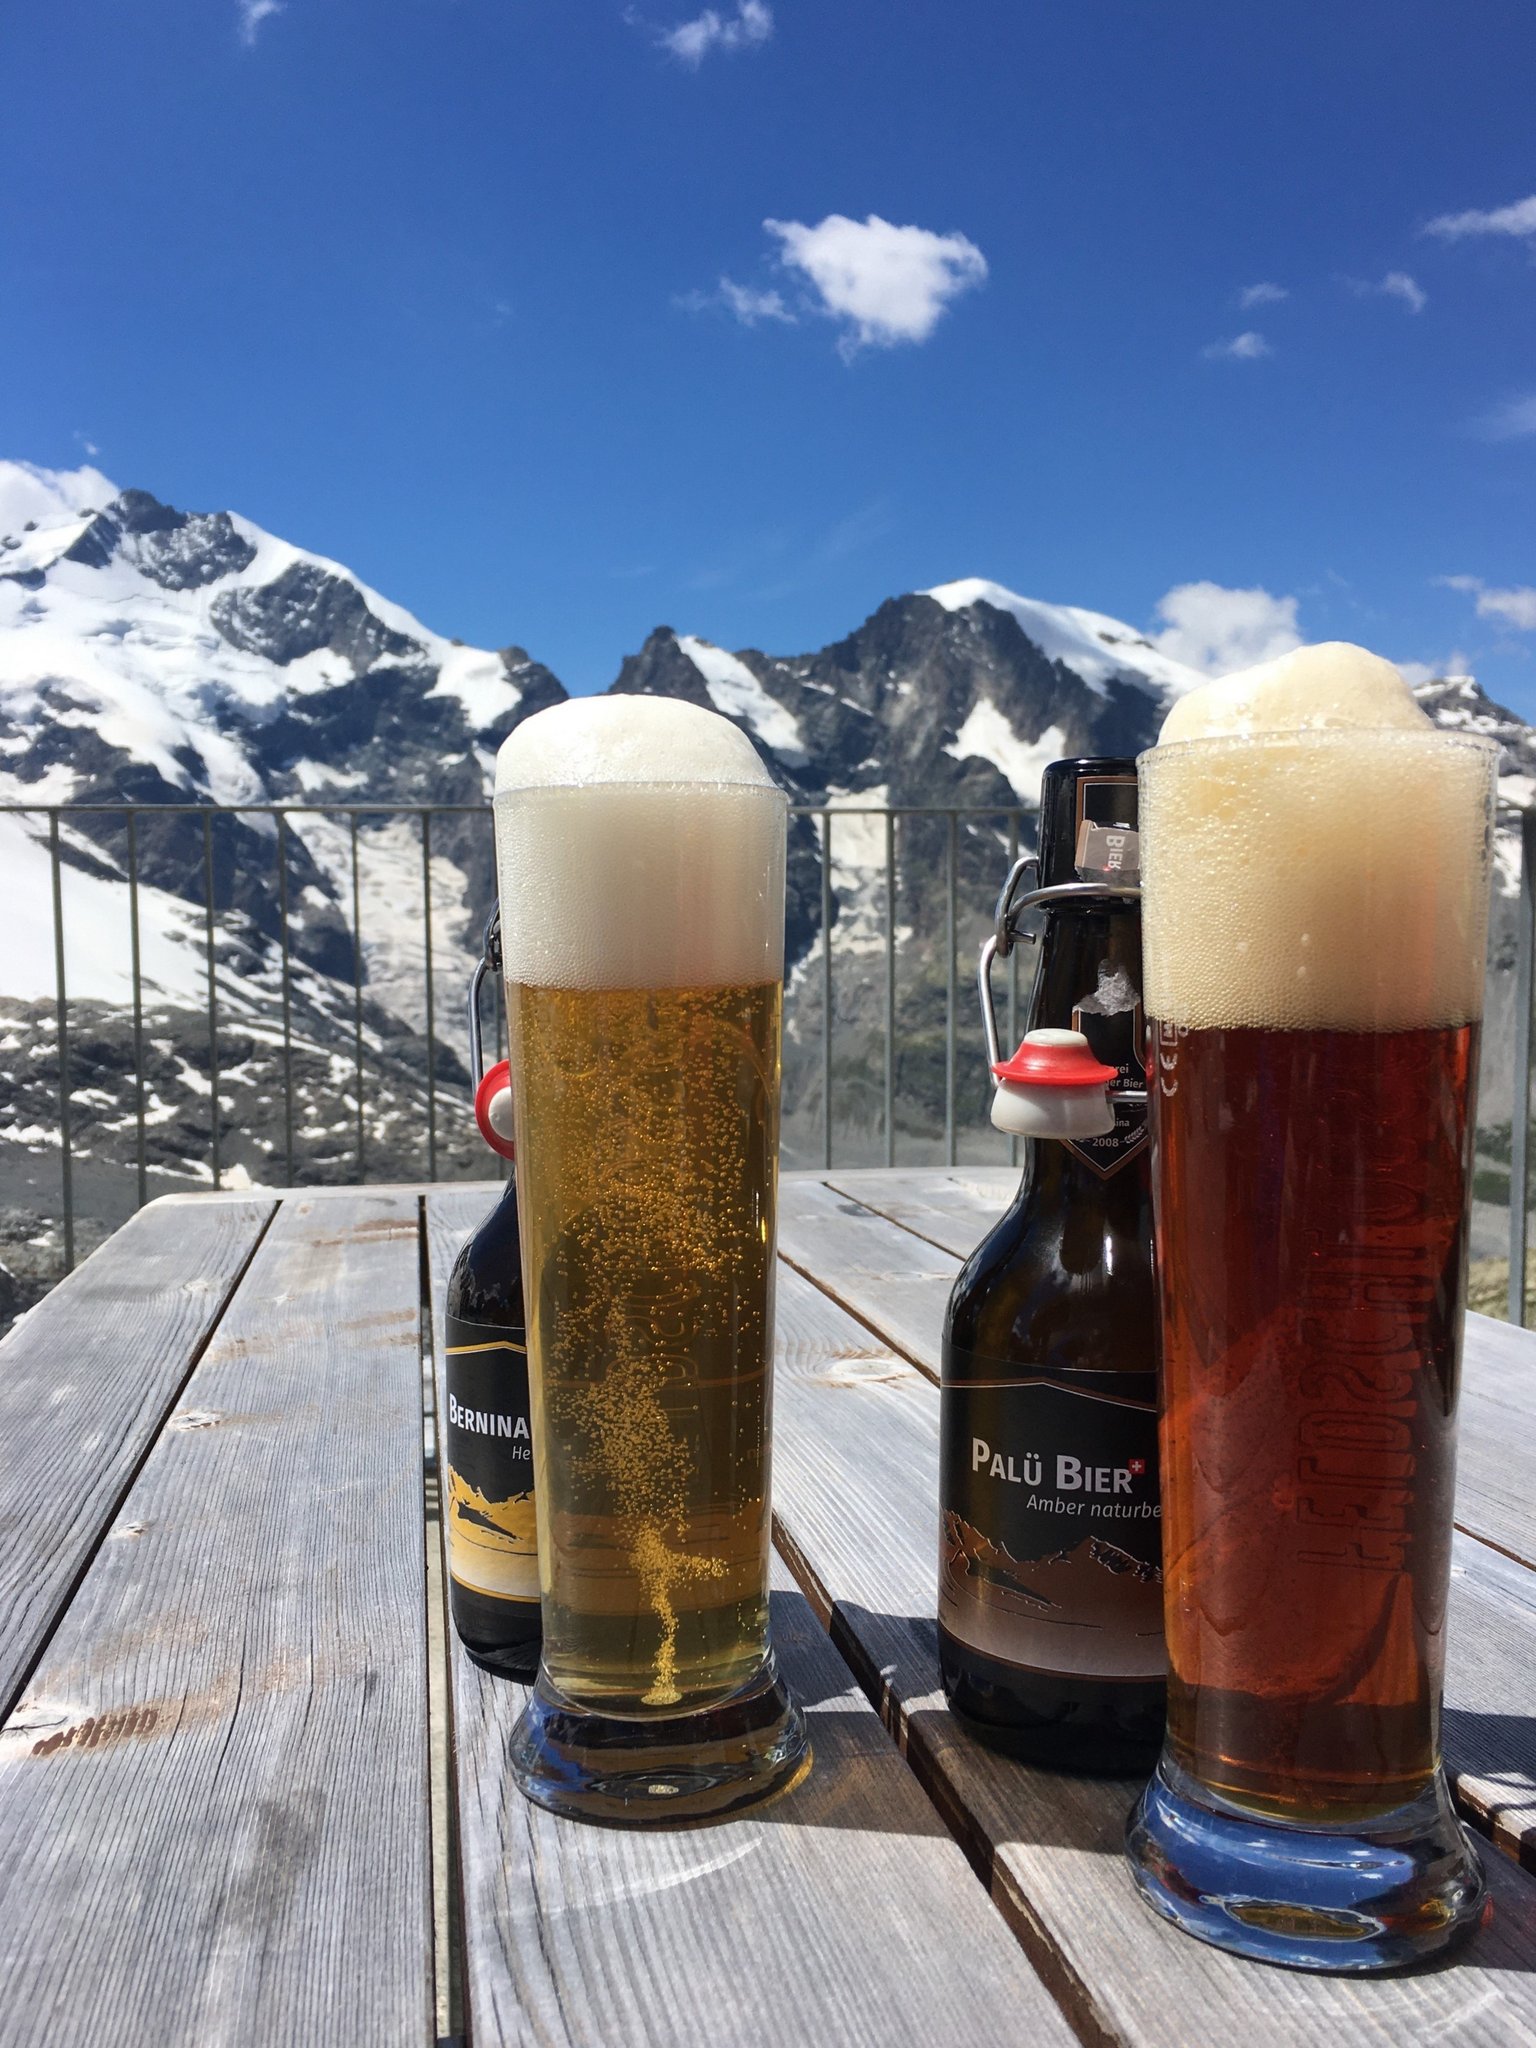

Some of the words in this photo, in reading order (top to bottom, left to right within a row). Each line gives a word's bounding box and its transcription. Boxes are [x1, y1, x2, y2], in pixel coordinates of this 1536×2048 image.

[1105, 834, 1126, 870] BIER
[1123, 1078, 1144, 1089] Bier
[1092, 1137, 1119, 1147] 2008
[449, 1392, 530, 1440] BERNINA
[972, 1436, 1042, 1487] PALÜ
[1056, 1454, 1133, 1494] BIER
[1026, 1493, 1085, 1516] Amber
